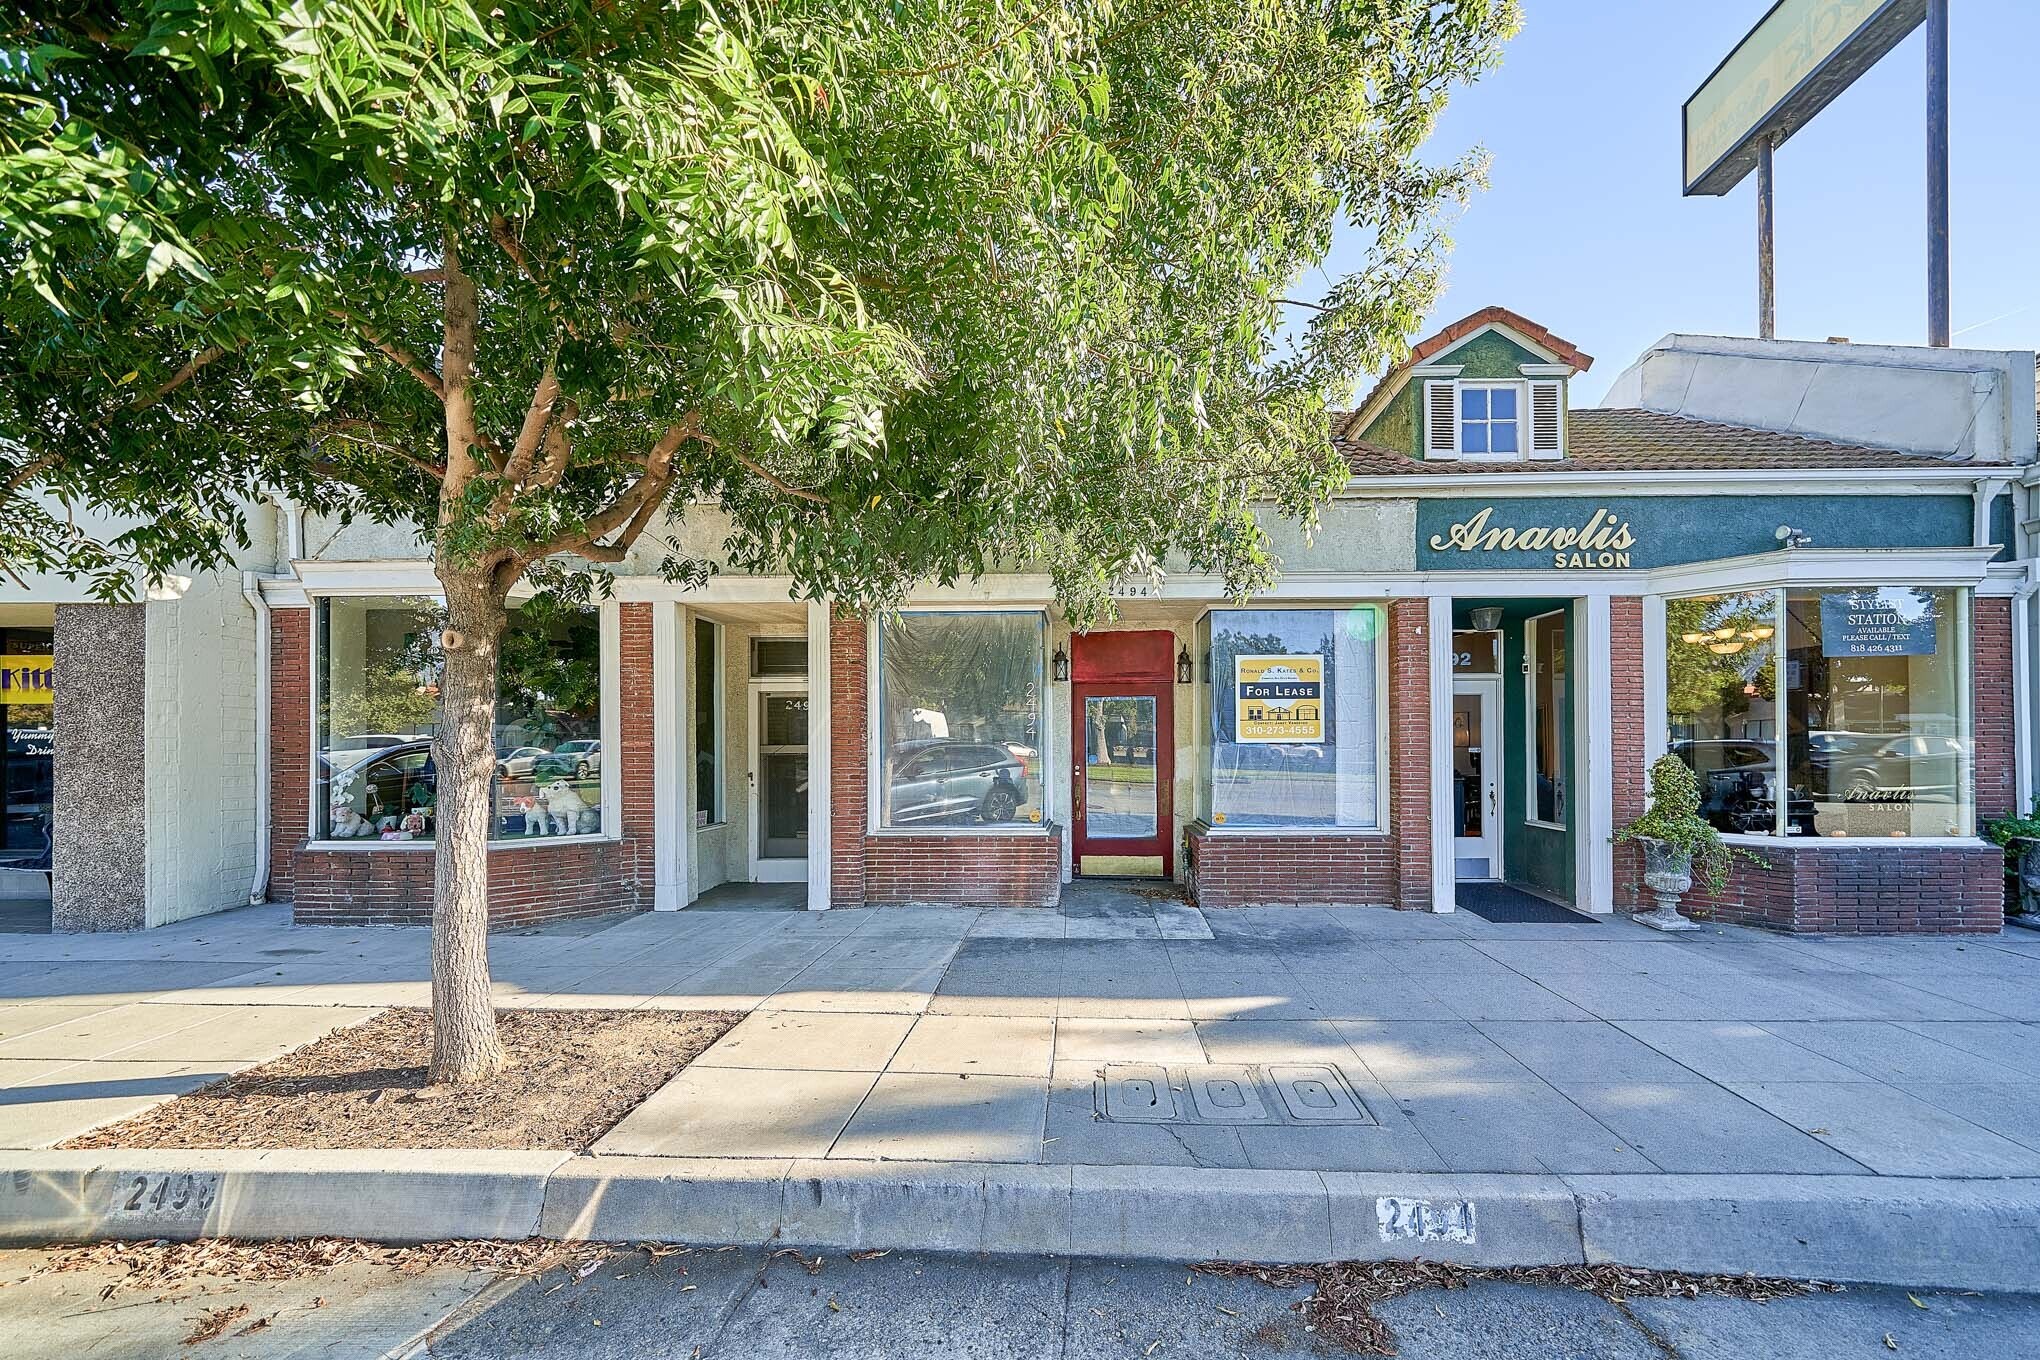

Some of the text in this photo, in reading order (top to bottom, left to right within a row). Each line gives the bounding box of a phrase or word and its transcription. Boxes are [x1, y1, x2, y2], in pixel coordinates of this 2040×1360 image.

[1430, 506, 1636, 551] Anavlis
[1555, 552, 1630, 569] SALON
[1108, 586, 1147, 597] 2494
[1851, 599, 1903, 610] STYLIST
[1848, 613, 1908, 625] STATION
[1850, 644, 1903, 653] 818 426 4311
[1025, 682, 1037, 741] 2494
[12, 728, 54, 743] Yummy
[1246, 726, 1316, 736] 310-273-4555
[1869, 803, 1915, 812] SALON
